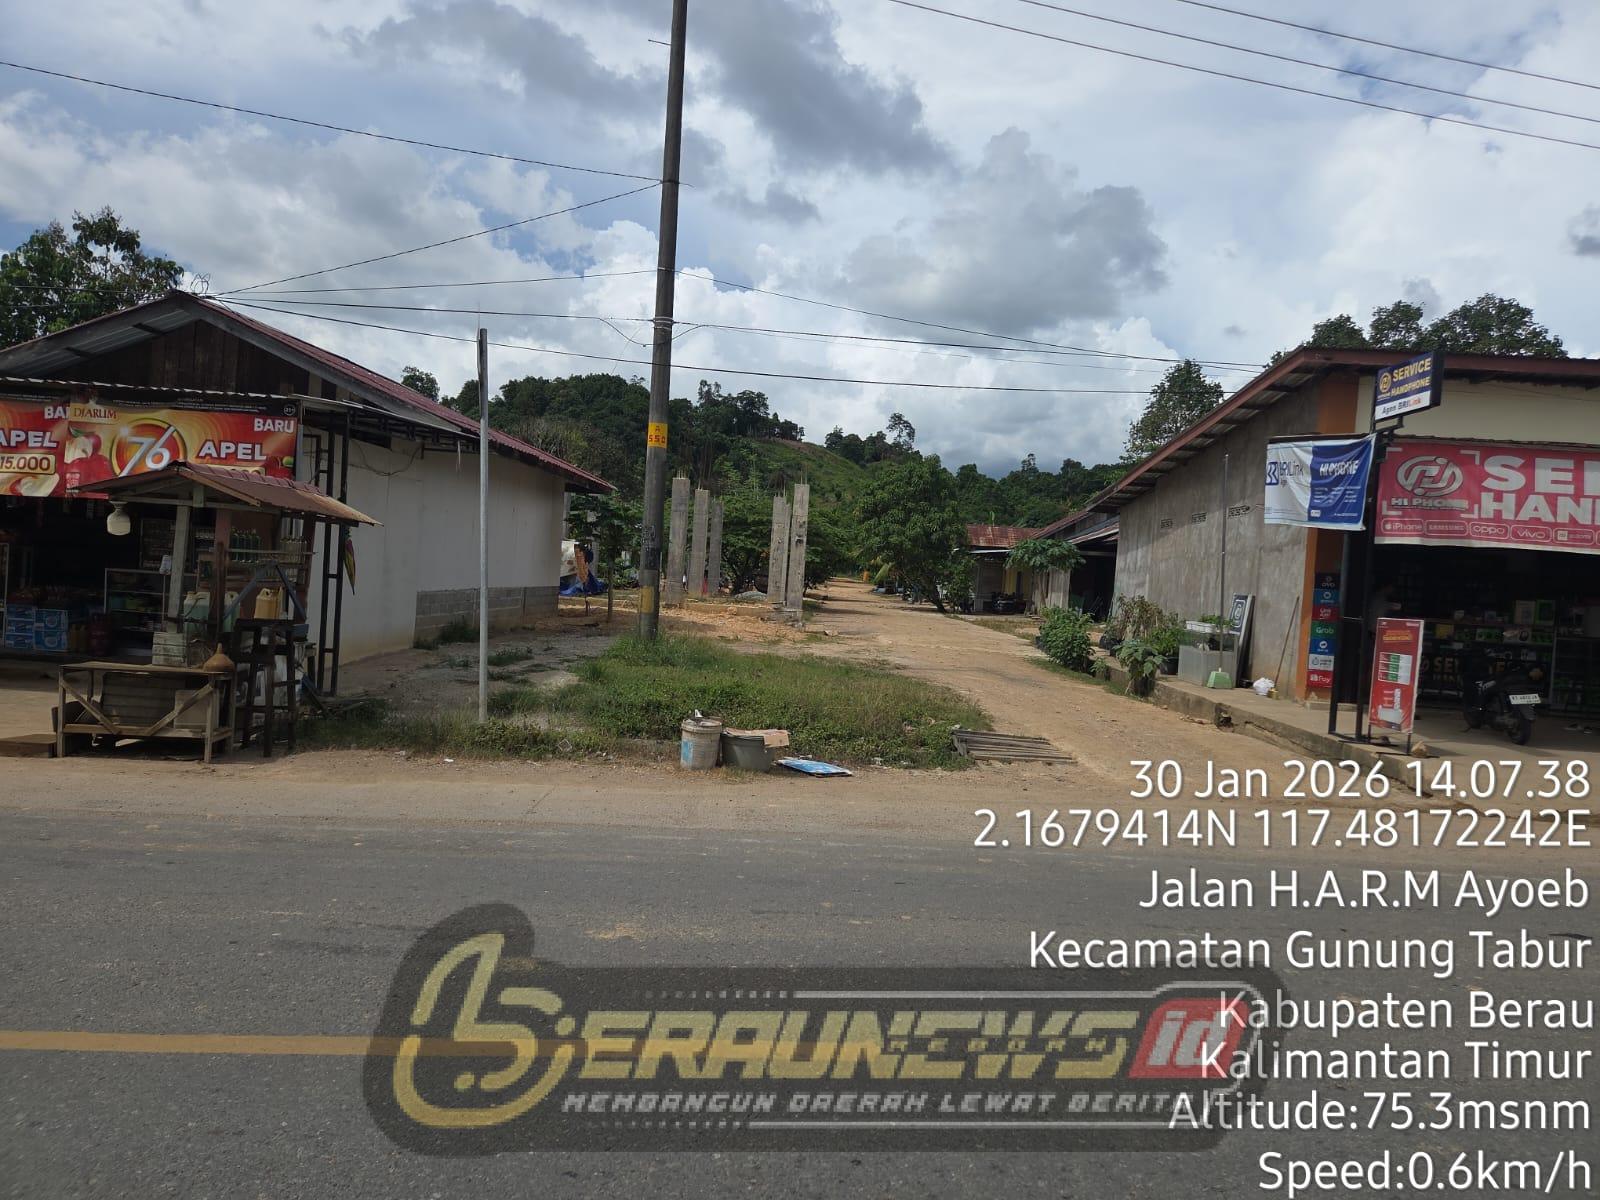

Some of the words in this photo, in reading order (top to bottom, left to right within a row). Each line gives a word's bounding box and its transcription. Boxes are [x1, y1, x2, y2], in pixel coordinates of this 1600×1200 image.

[1393, 358, 1432, 382] SERVICE
[44, 406, 70, 419] BA
[74, 407, 117, 419] DJARUM
[254, 417, 294, 433] BARU
[118, 425, 176, 478] 76
[199, 440, 267, 460] APEL
[1391, 498, 1408, 506] HI
[1481, 492, 1600, 525] HAN
[1392, 523, 1422, 531] iPhone
[1316, 626, 1334, 634] Grab
